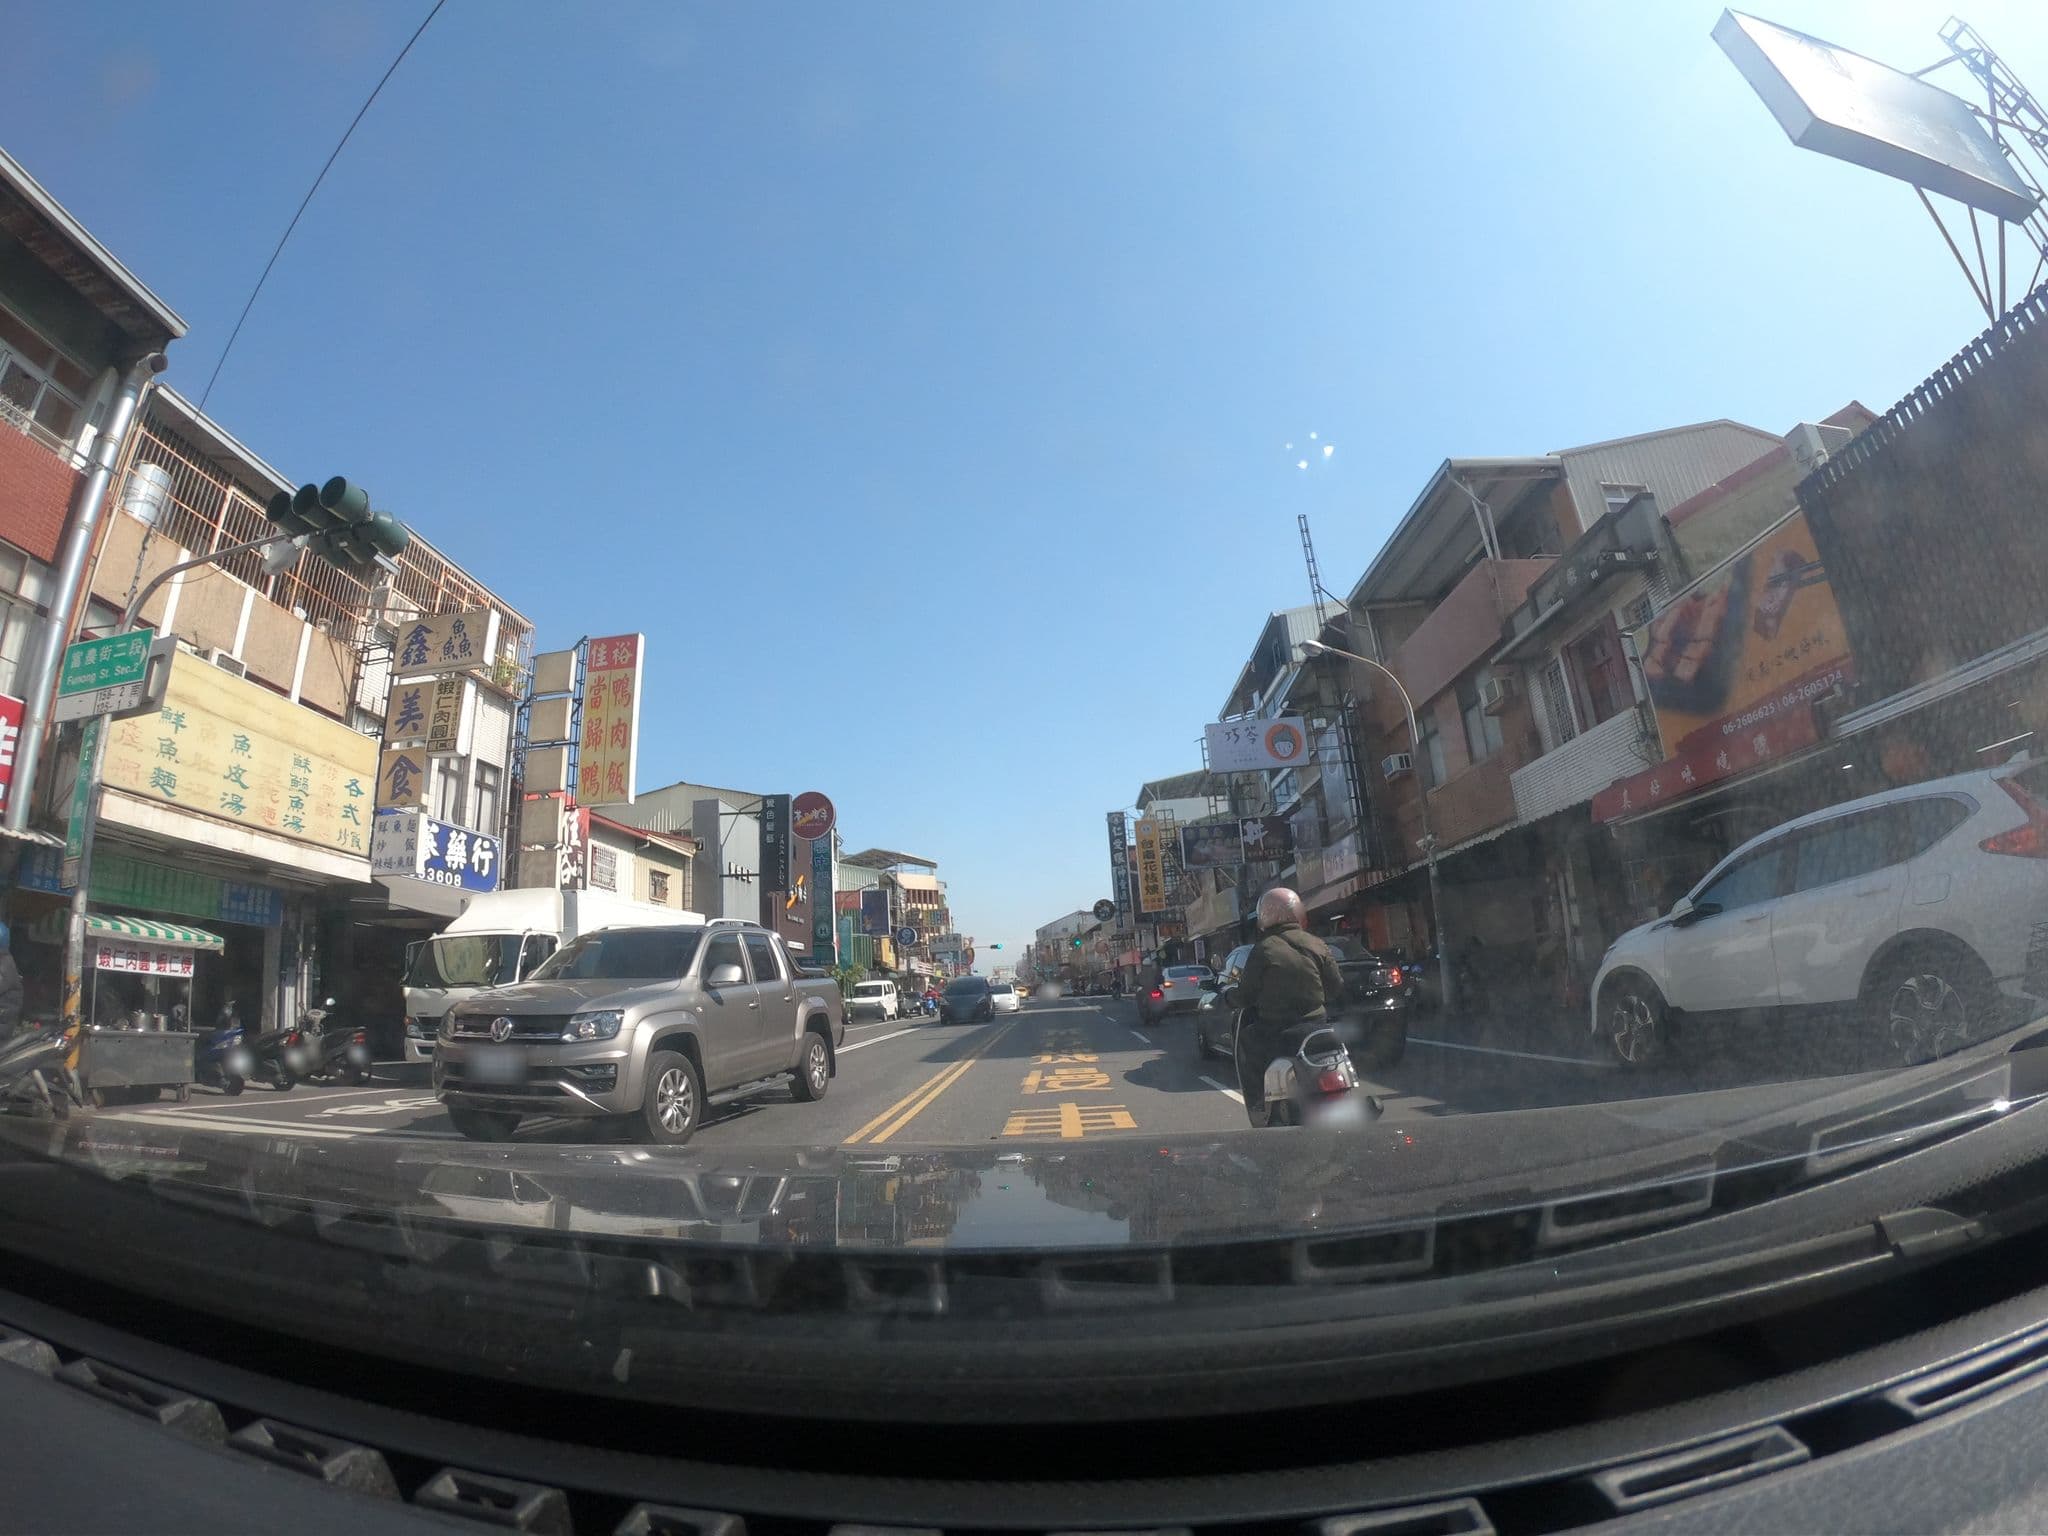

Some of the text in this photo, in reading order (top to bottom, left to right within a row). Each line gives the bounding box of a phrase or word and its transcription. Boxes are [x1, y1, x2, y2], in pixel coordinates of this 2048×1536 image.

[71, 637, 143, 669] 富農街二段
[149, 704, 187, 798] 鮮魚麵
[219, 733, 252, 817] 魚皮湯
[581, 674, 607, 797] 當歸鴨
[605, 673, 631, 795] 鴨肉飯
